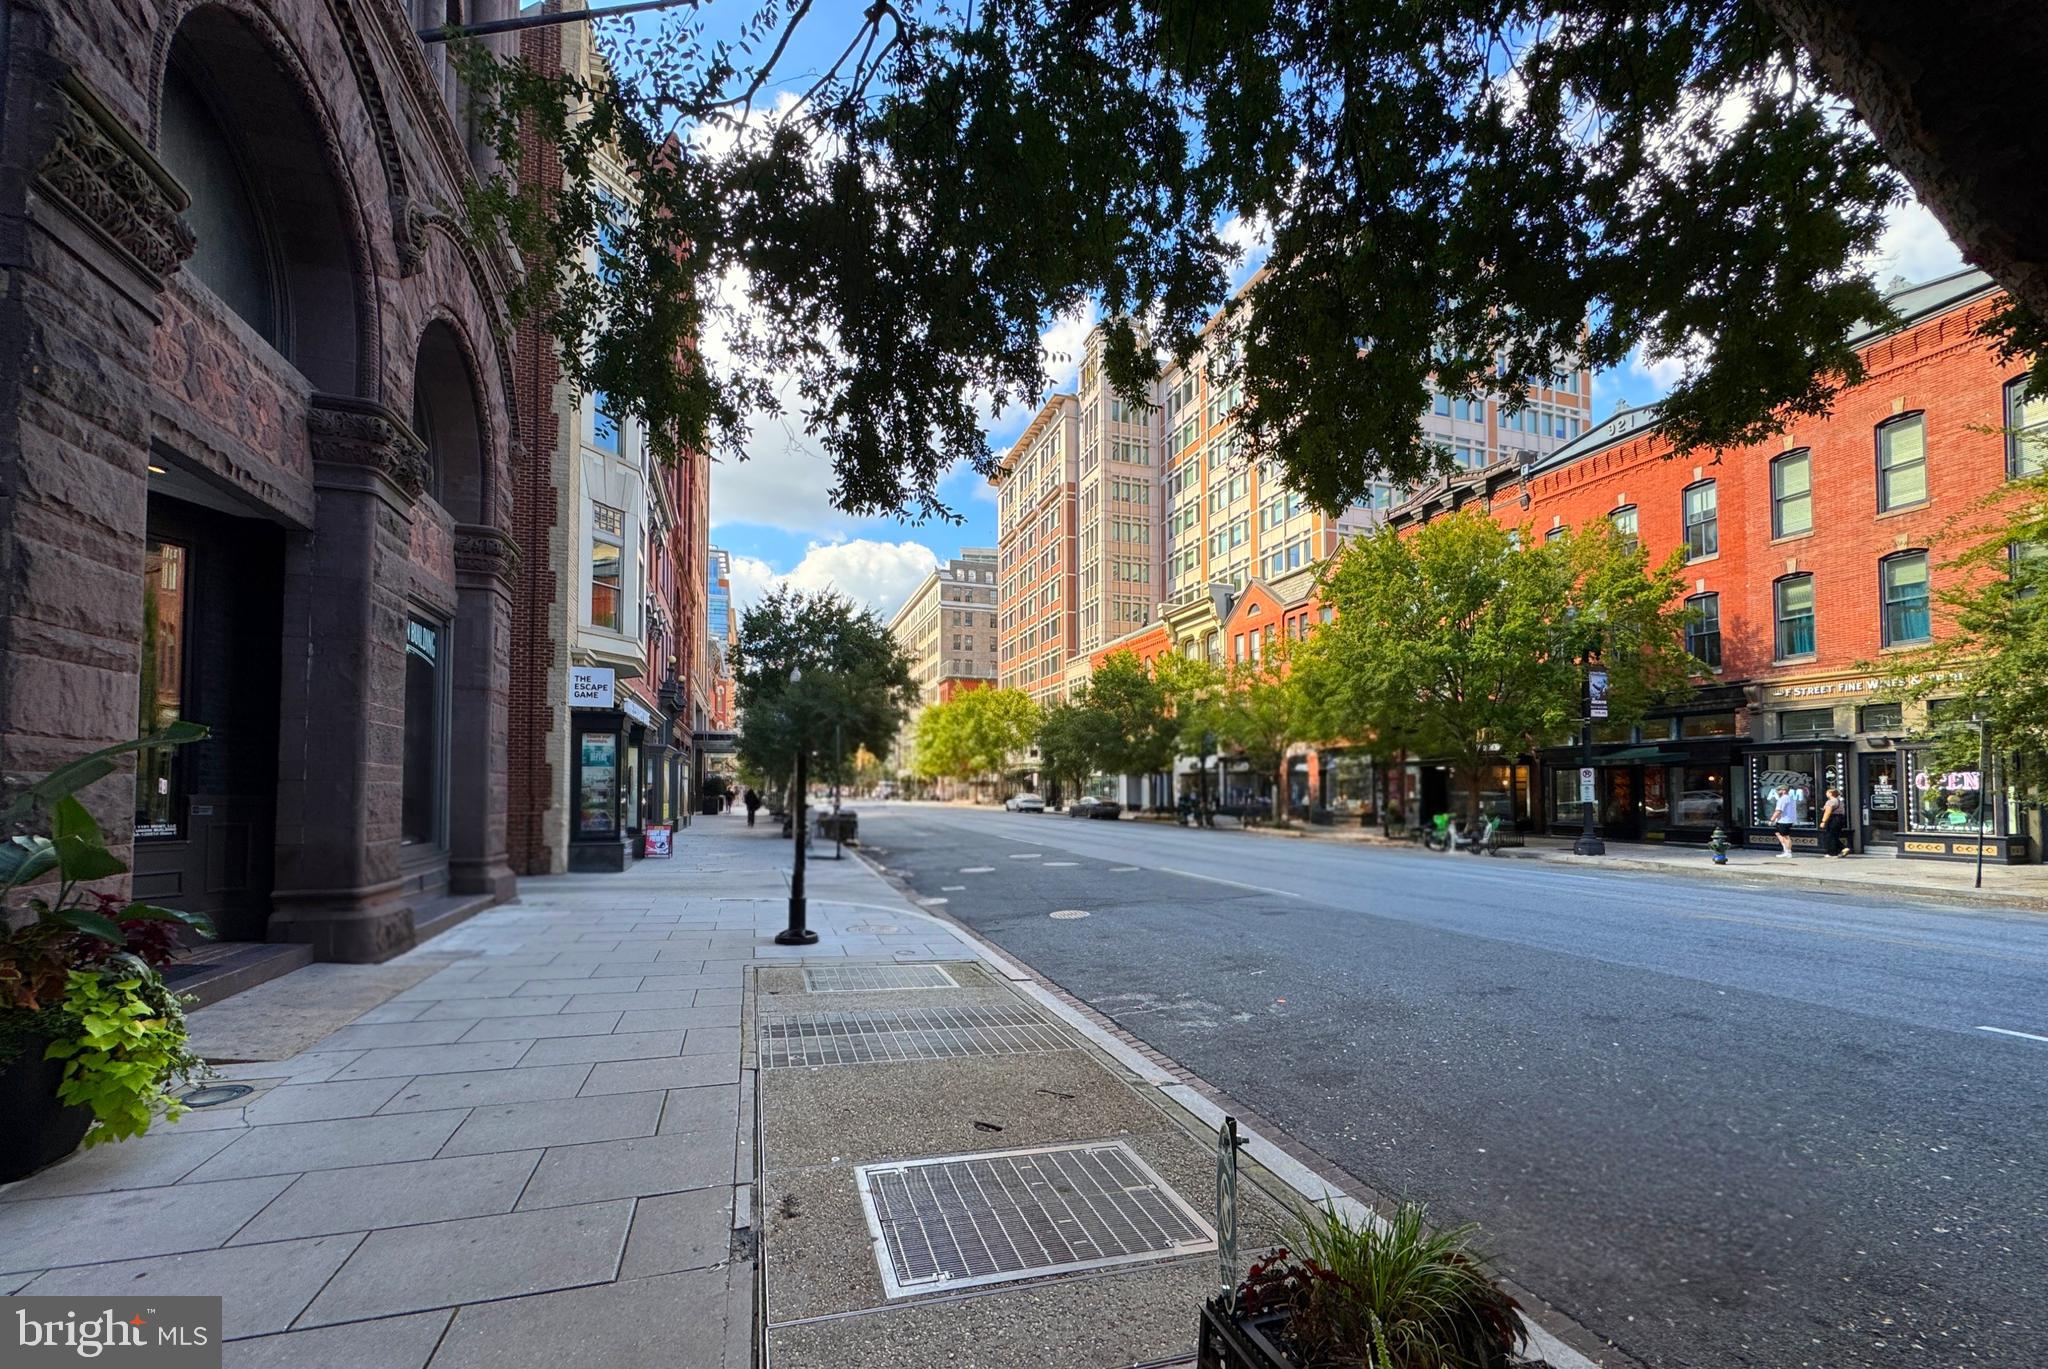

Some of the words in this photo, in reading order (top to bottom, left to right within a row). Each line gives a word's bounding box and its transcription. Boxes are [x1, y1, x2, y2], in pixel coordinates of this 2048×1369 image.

[1608, 414, 1635, 437] 921
[574, 675, 592, 683] THE
[574, 683, 609, 692] ESCAPE
[1794, 685, 1833, 696] STREET
[1838, 681, 1864, 692] FINE
[574, 691, 600, 699] GAME
